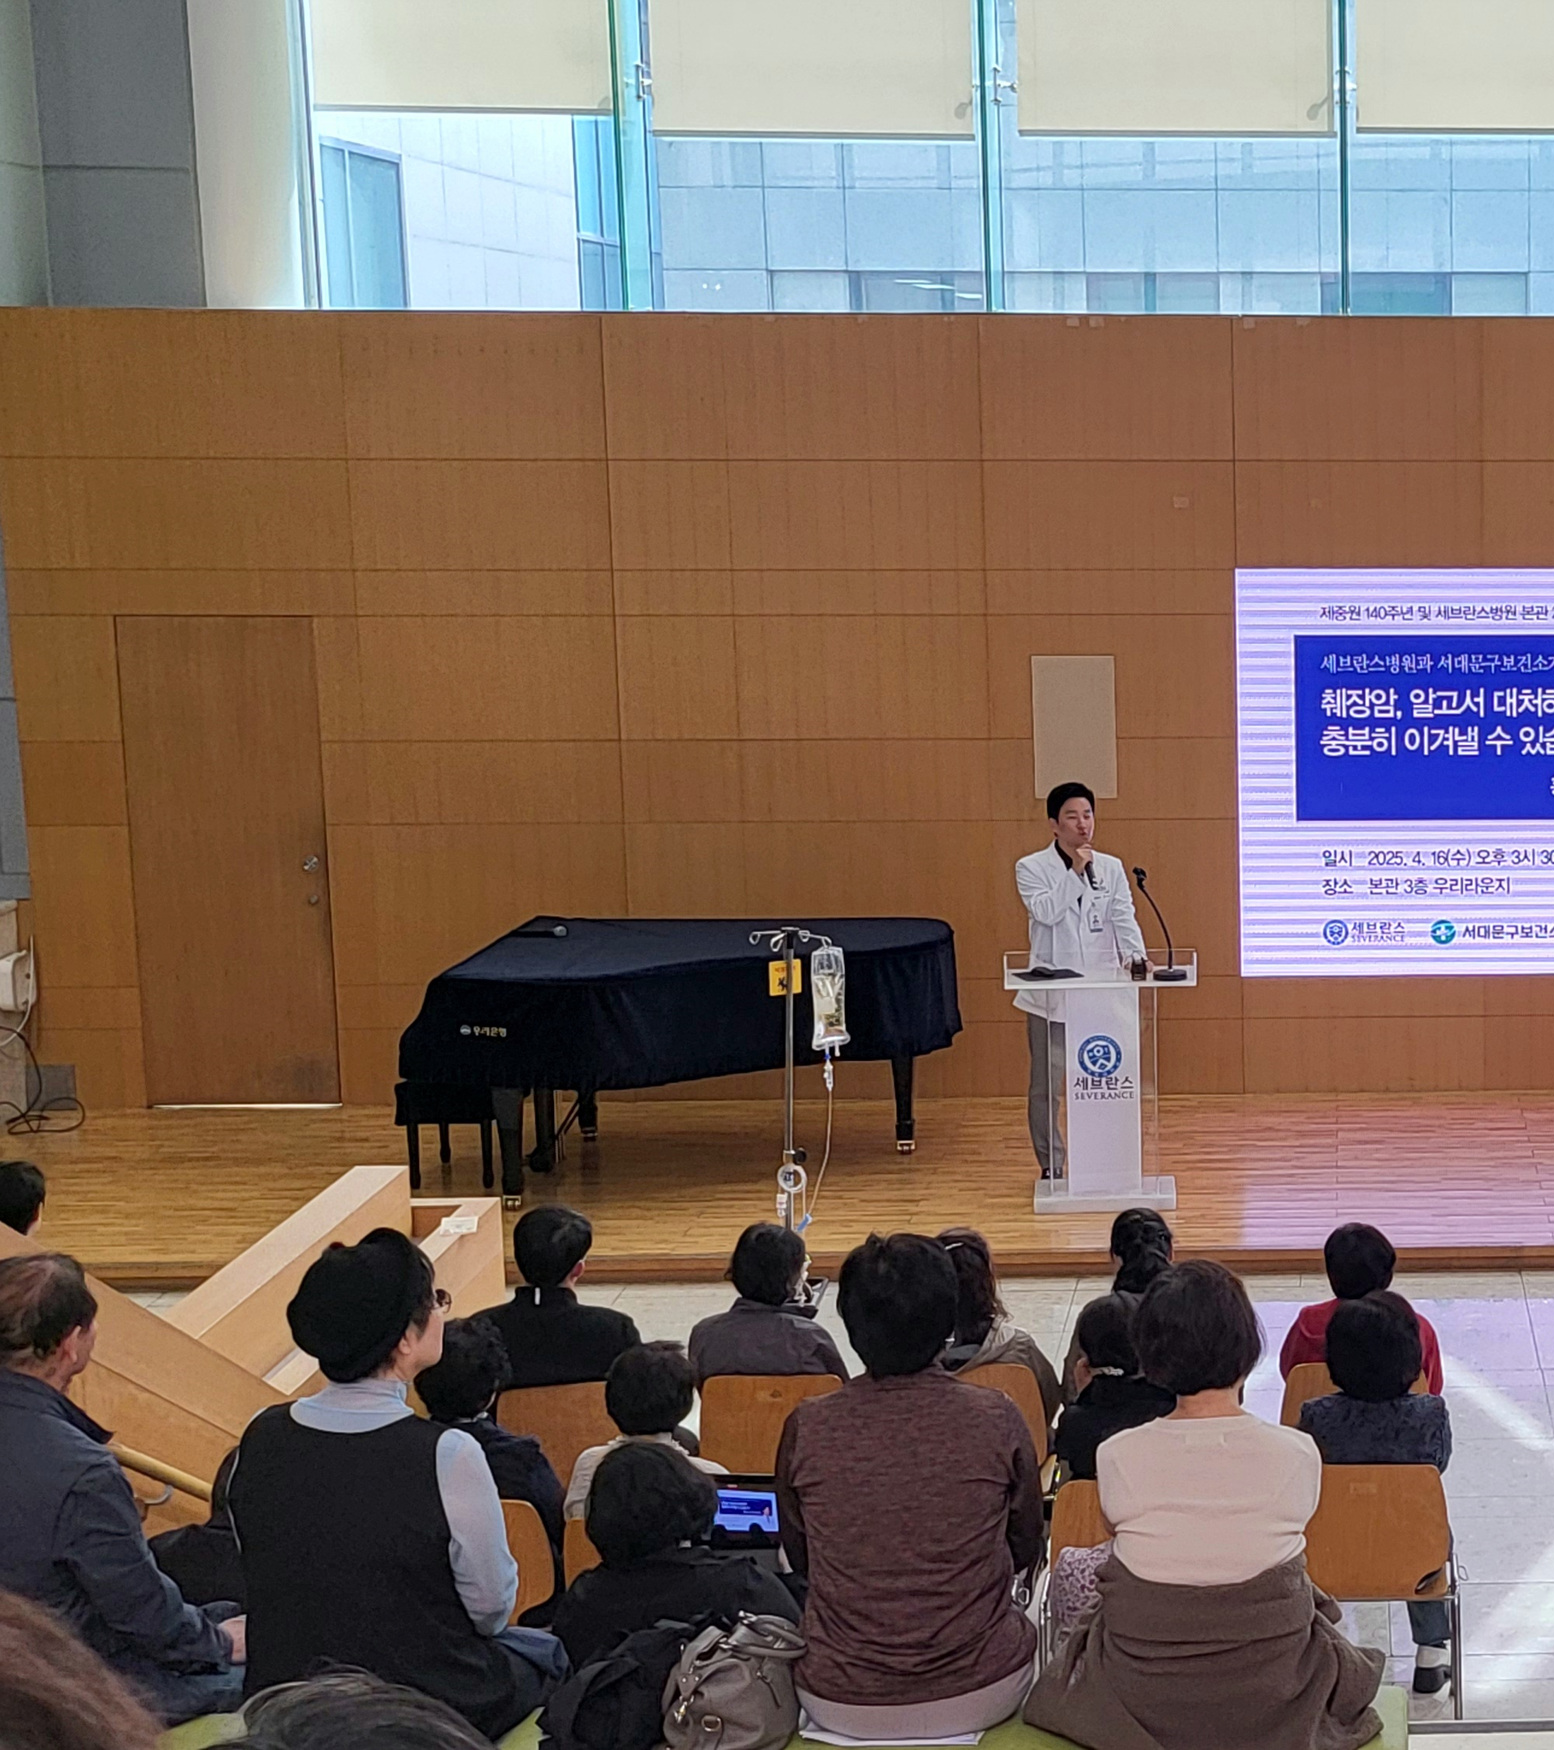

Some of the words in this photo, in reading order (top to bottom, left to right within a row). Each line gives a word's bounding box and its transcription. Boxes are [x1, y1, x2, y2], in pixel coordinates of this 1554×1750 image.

[1320, 605, 1361, 621] 제중원
[1364, 605, 1414, 621] 140주년
[1418, 605, 1431, 620] 및
[1436, 605, 1517, 621] 세브란스병원
[1520, 605, 1548, 620] 본관
[1320, 654, 1433, 674] 세브란스병원과
[1321, 688, 1402, 720] 췌장암,
[1409, 688, 1485, 718] 알고서
[1320, 726, 1396, 756] 충분히
[1404, 725, 1479, 755] 이겨낼
[1486, 725, 1513, 755] 수
[1322, 849, 1353, 867] 일시
[1367, 851, 1408, 867] 2025.
[1412, 851, 1426, 866] 4.
[1431, 849, 1472, 867] 16(수)
[1475, 849, 1507, 866] 오후
[1511, 848, 1536, 866] 3시
[1322, 877, 1354, 896] 장소
[1368, 877, 1400, 895] 본관
[1404, 877, 1428, 894] 3층
[1433, 876, 1511, 895] 우리라운지
[1351, 921, 1405, 934] 세브란스
[1074, 1075, 1134, 1090] 세브란스
[1075, 1091, 1134, 1100] SEVERANCE
